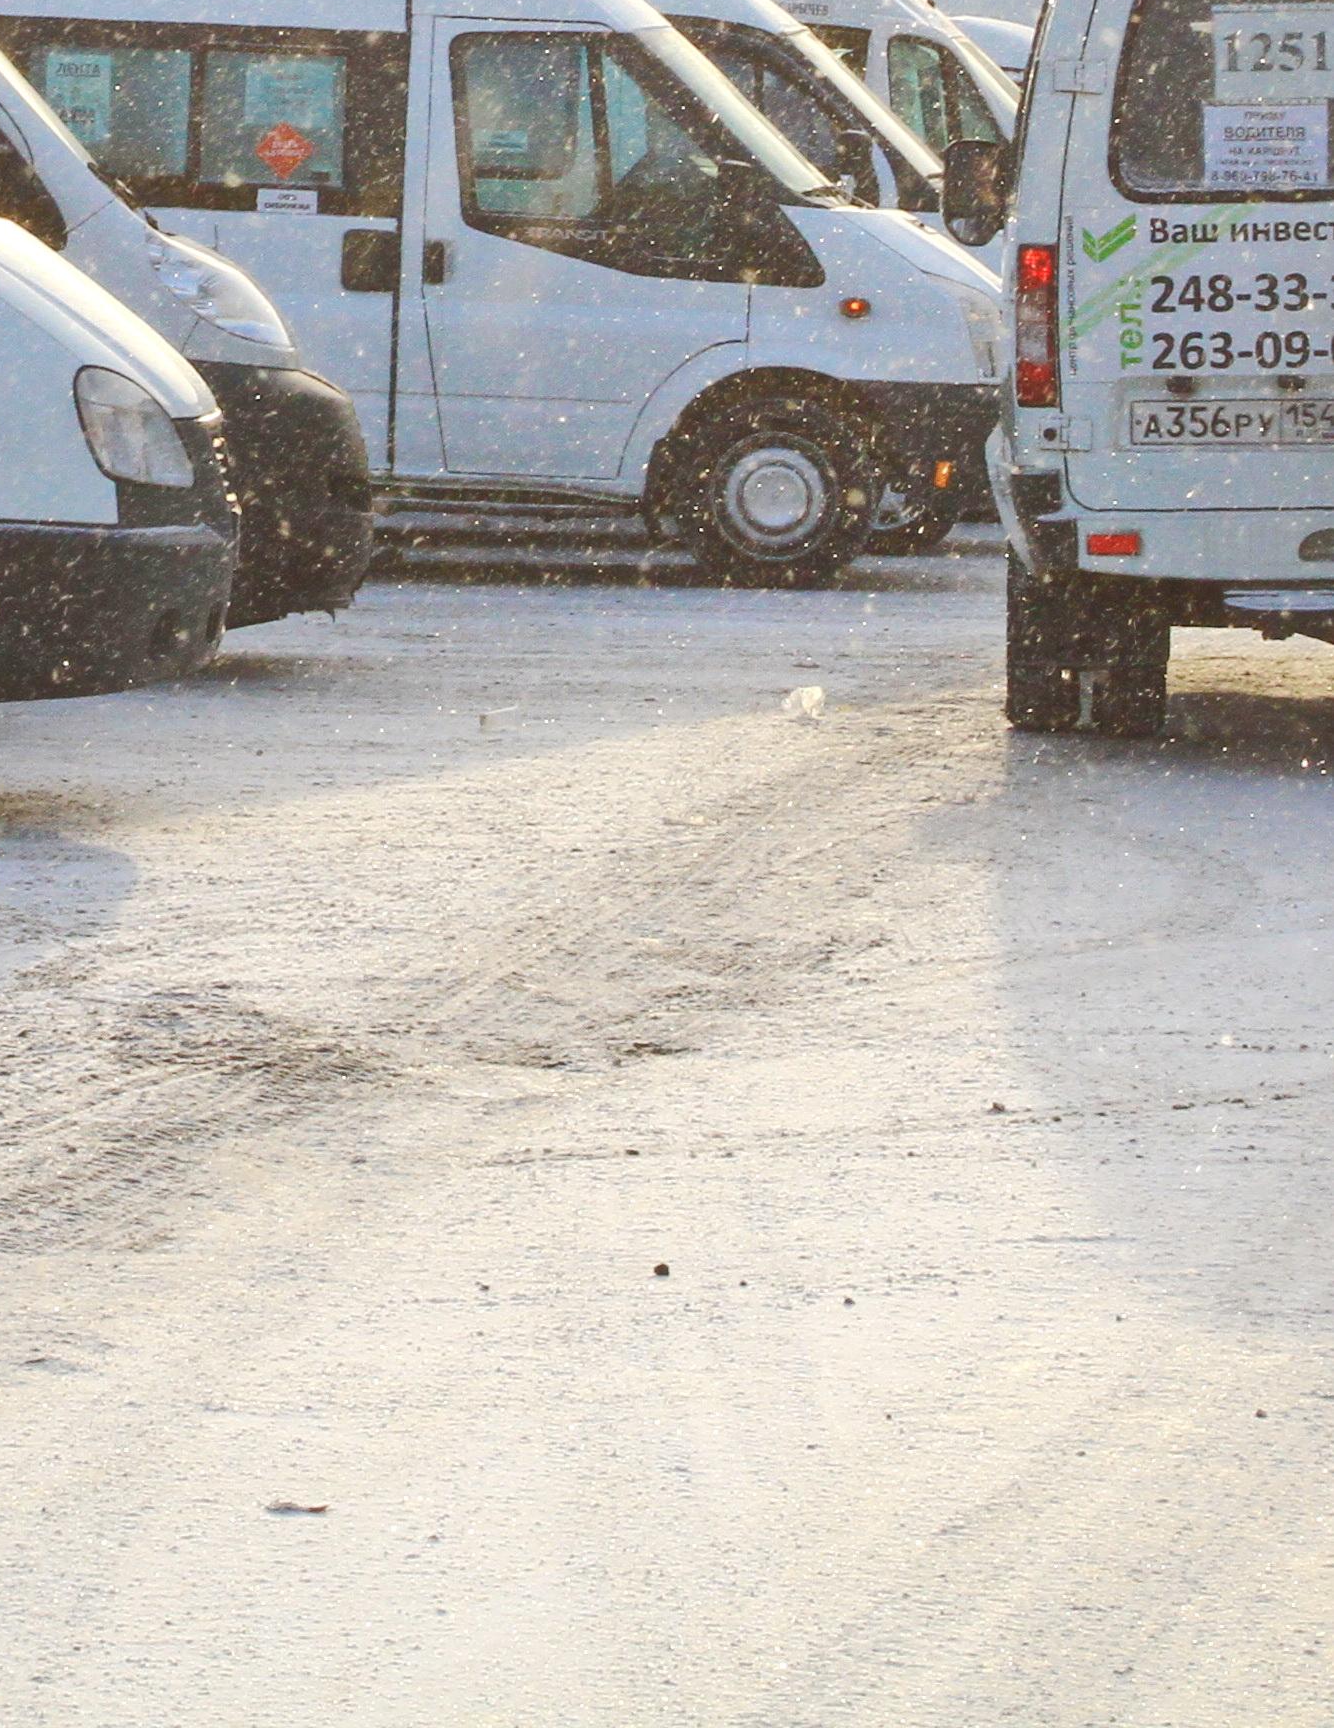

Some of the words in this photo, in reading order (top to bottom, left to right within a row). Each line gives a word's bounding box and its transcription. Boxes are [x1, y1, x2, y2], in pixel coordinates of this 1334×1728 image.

[1221, 32, 1332, 72] 1251
[1224, 127, 1305, 139] ВОДИТЕЛЯ
[1150, 218, 1218, 243] Ваш
[1150, 273, 1334, 313] 248-33-
[1152, 331, 1334, 370] 263-09-
